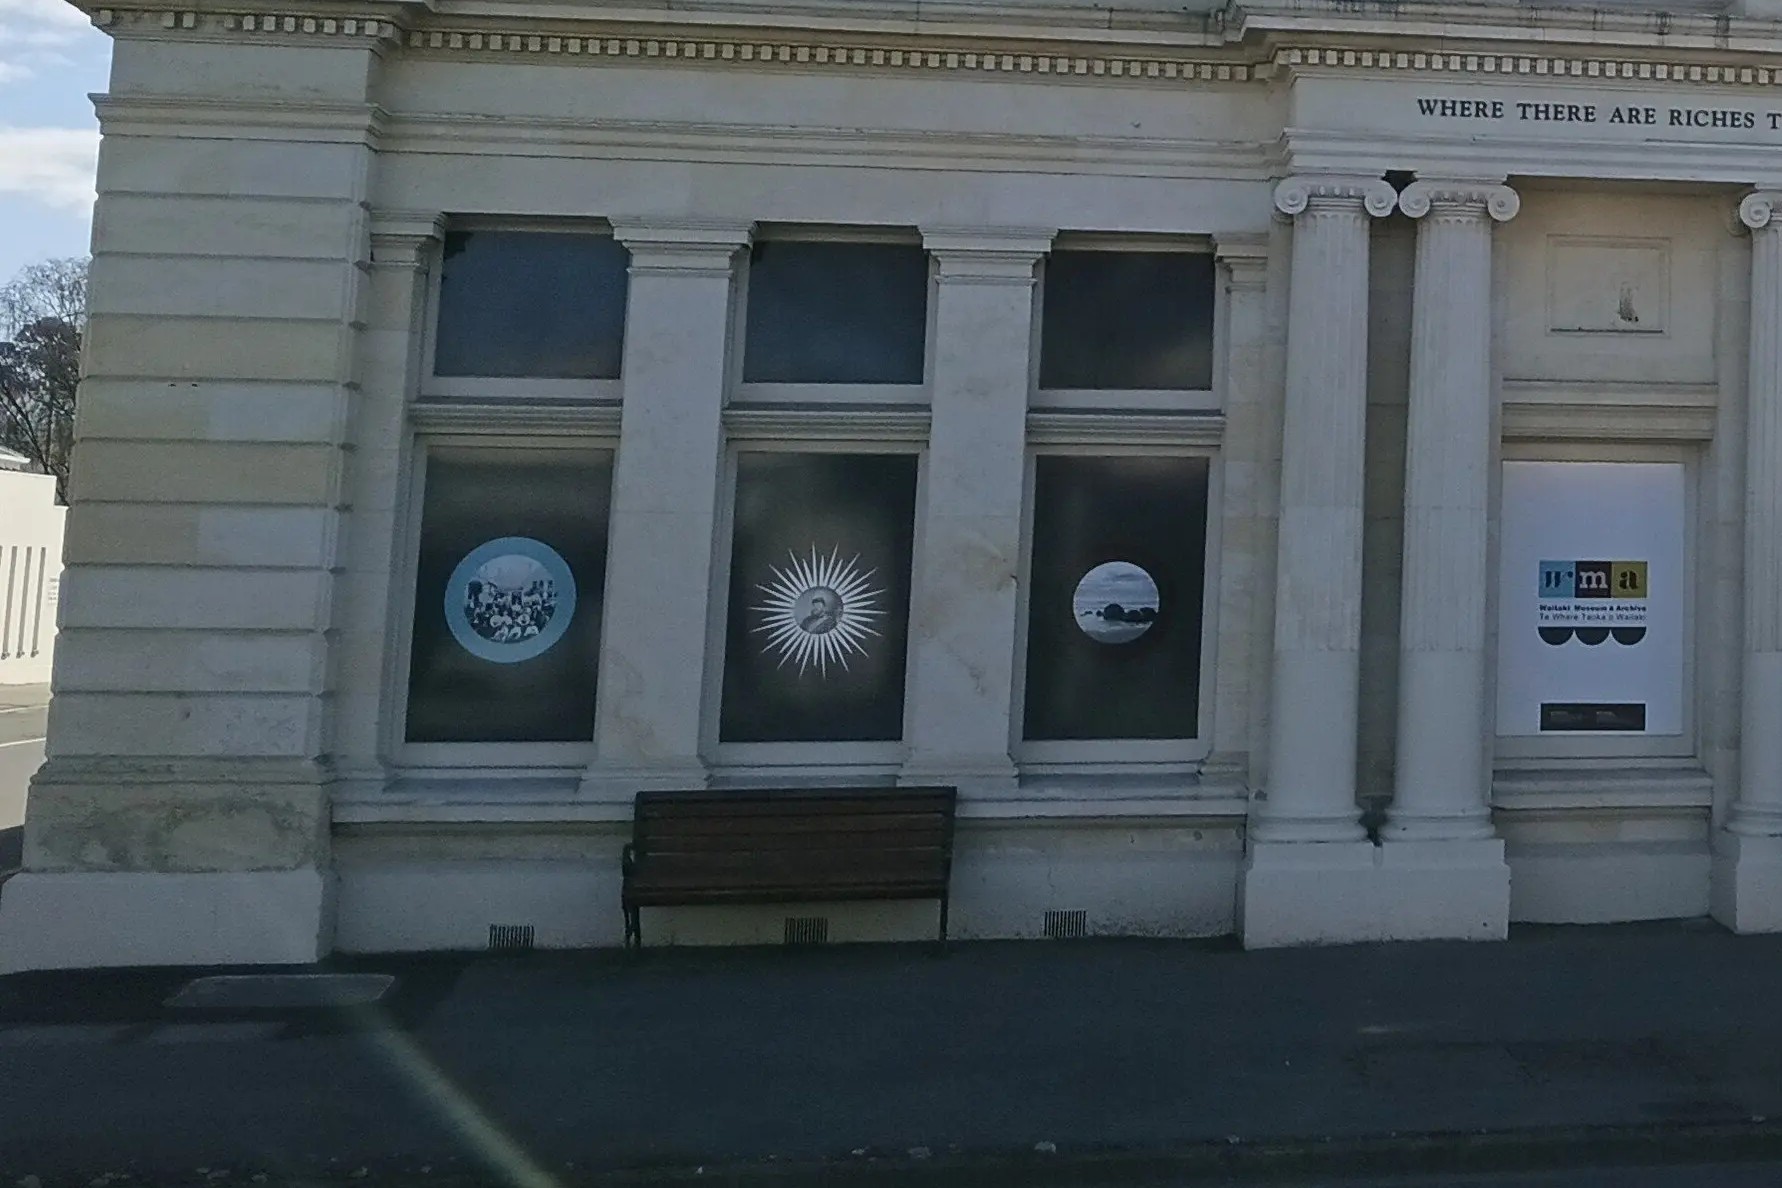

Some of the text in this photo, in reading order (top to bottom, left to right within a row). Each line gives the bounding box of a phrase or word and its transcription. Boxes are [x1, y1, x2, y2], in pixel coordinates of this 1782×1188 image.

[1417, 98, 1504, 119] WHERE
[1516, 102, 1597, 123] THERE
[1609, 106, 1657, 125] ARE
[1668, 109, 1756, 129] RICHES
